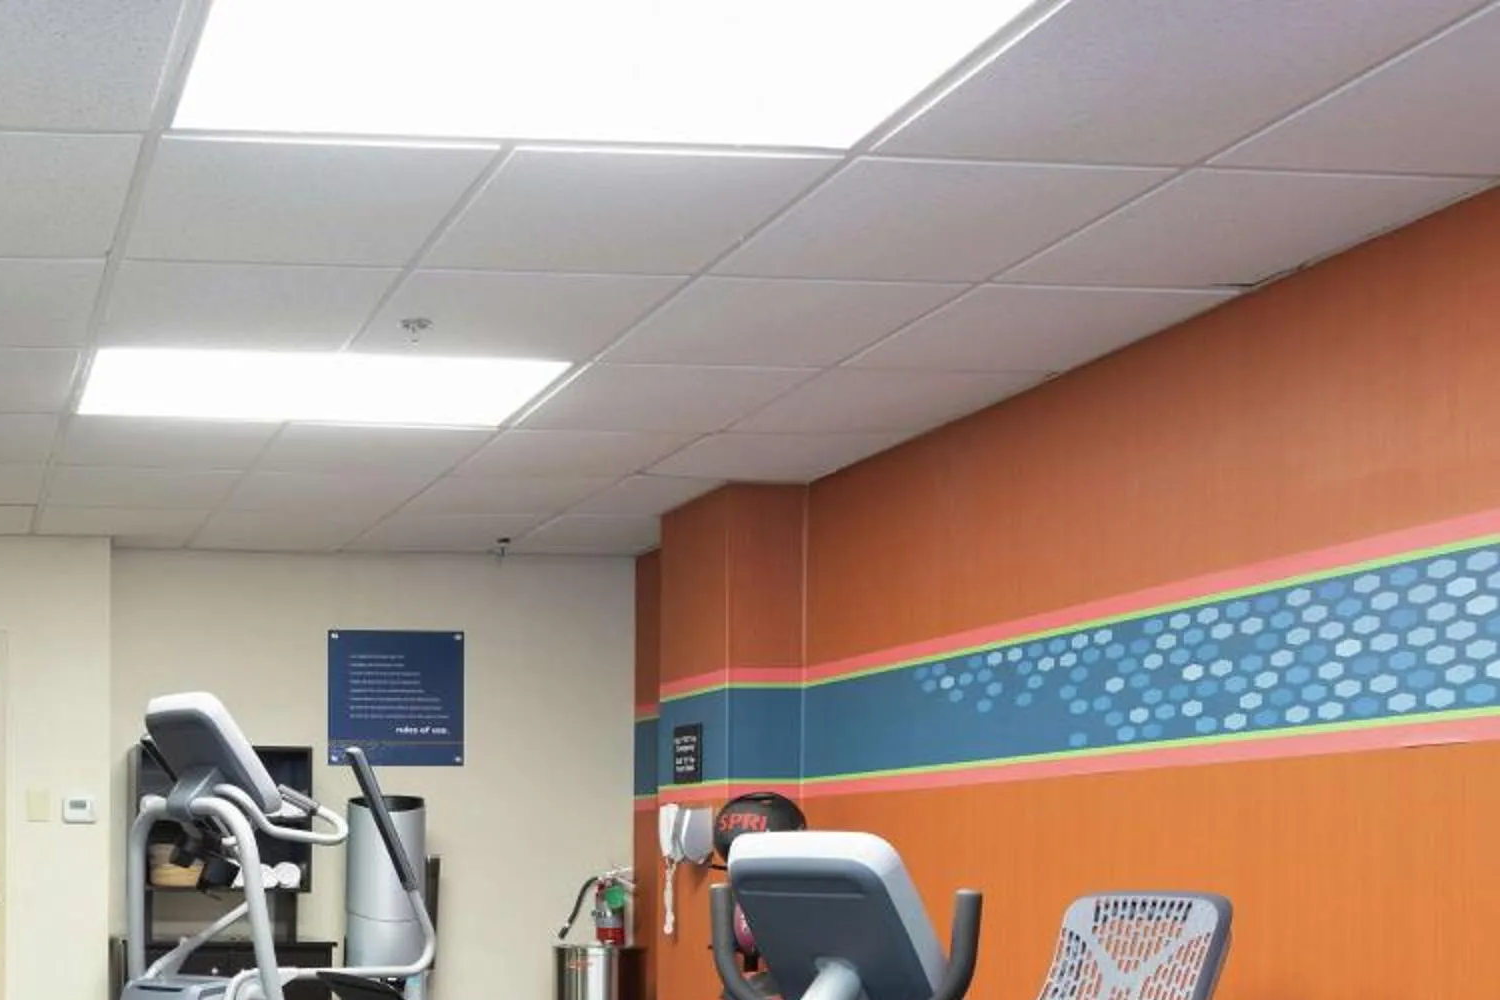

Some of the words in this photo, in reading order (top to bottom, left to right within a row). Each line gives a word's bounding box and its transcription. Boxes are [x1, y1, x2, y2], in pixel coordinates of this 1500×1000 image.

[395, 725, 418, 735] rules
[419, 725, 431, 734] of
[719, 812, 768, 832] SPRI
